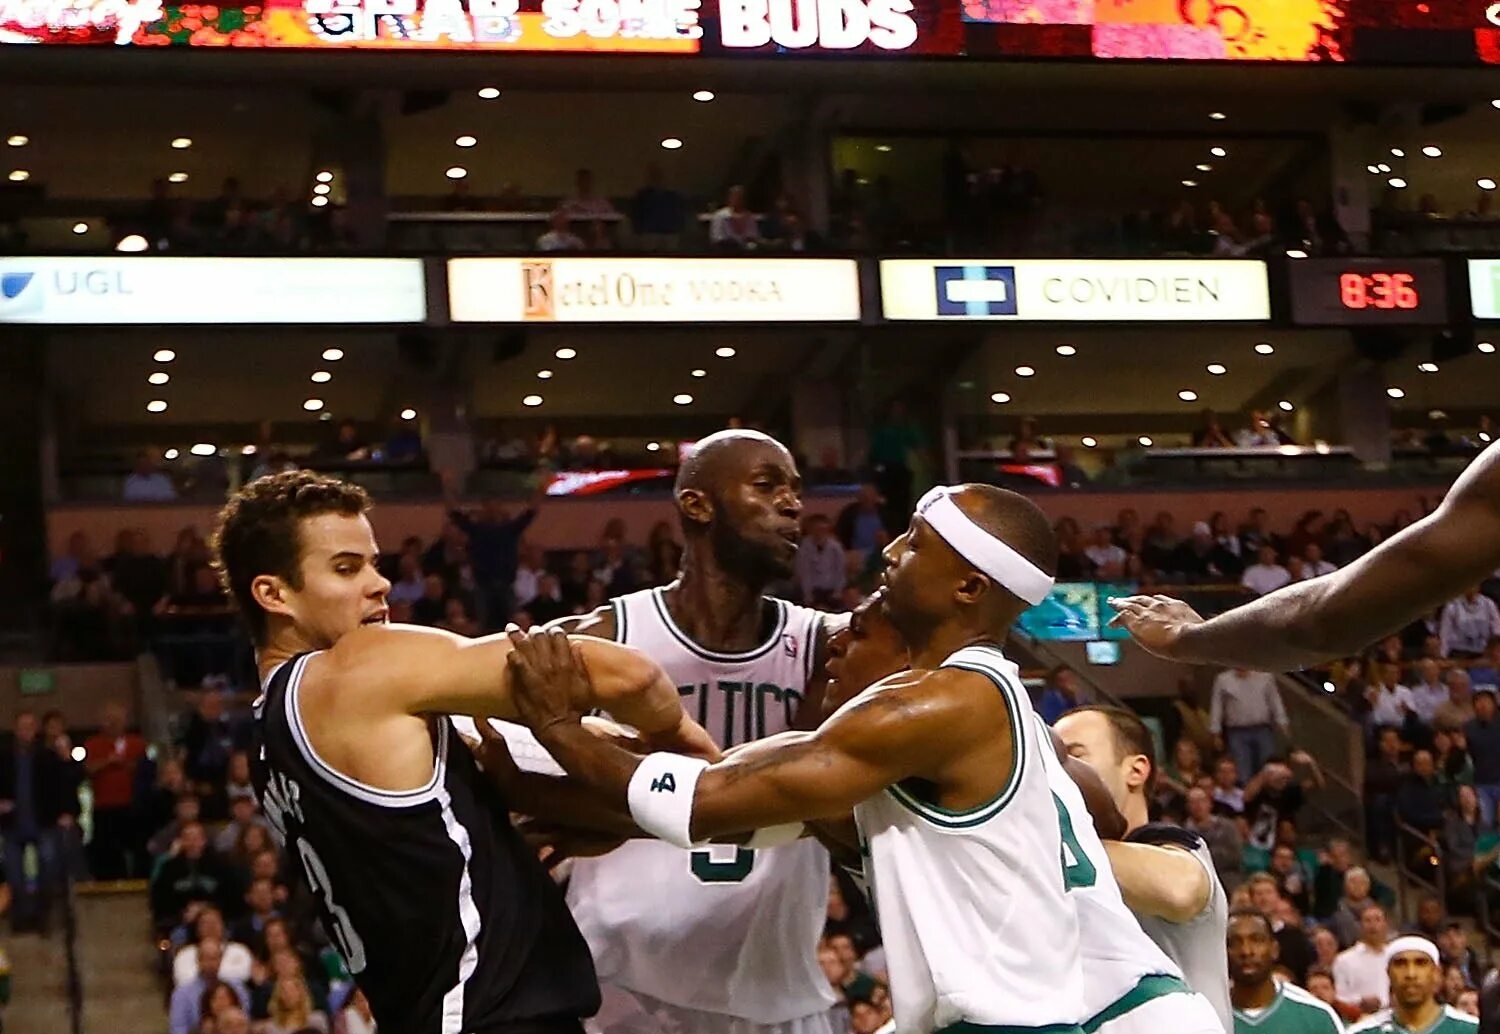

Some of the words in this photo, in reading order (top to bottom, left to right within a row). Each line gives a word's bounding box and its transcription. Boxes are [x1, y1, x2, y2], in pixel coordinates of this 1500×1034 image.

[721, 0, 919, 49] BUDS
[54, 269, 134, 295] UGL
[1042, 277, 1221, 304] COVIDIEN
[1340, 273, 1418, 309] 8:36
